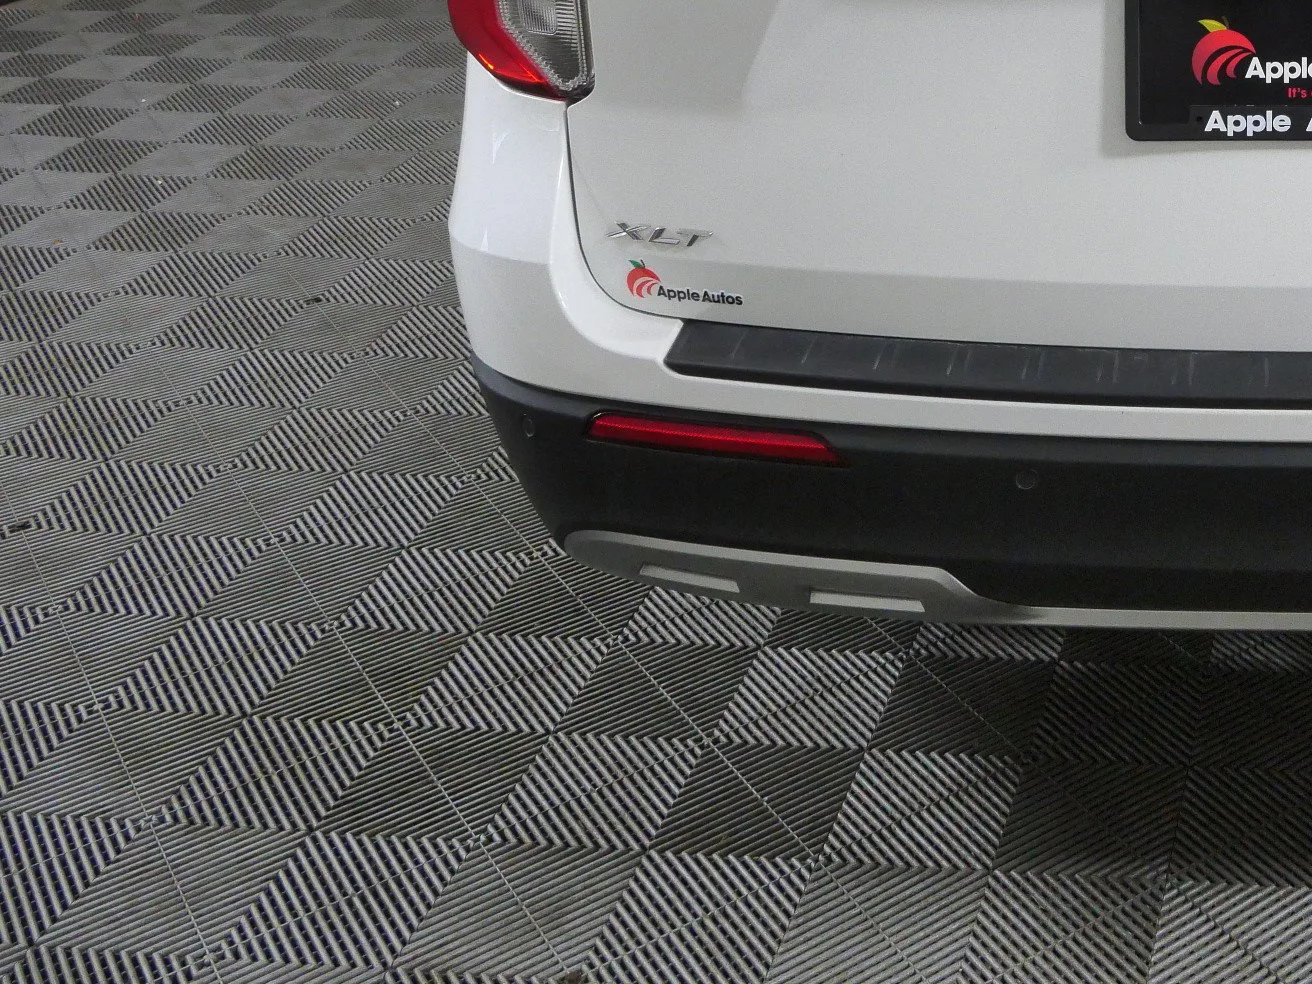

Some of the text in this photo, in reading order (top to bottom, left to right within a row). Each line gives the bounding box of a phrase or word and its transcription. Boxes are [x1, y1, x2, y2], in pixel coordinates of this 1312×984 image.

[1288, 87, 1307, 99] It's
[1204, 110, 1292, 137] Apple
[605, 219, 714, 247] XLT
[656, 285, 744, 306] Apple Autos
